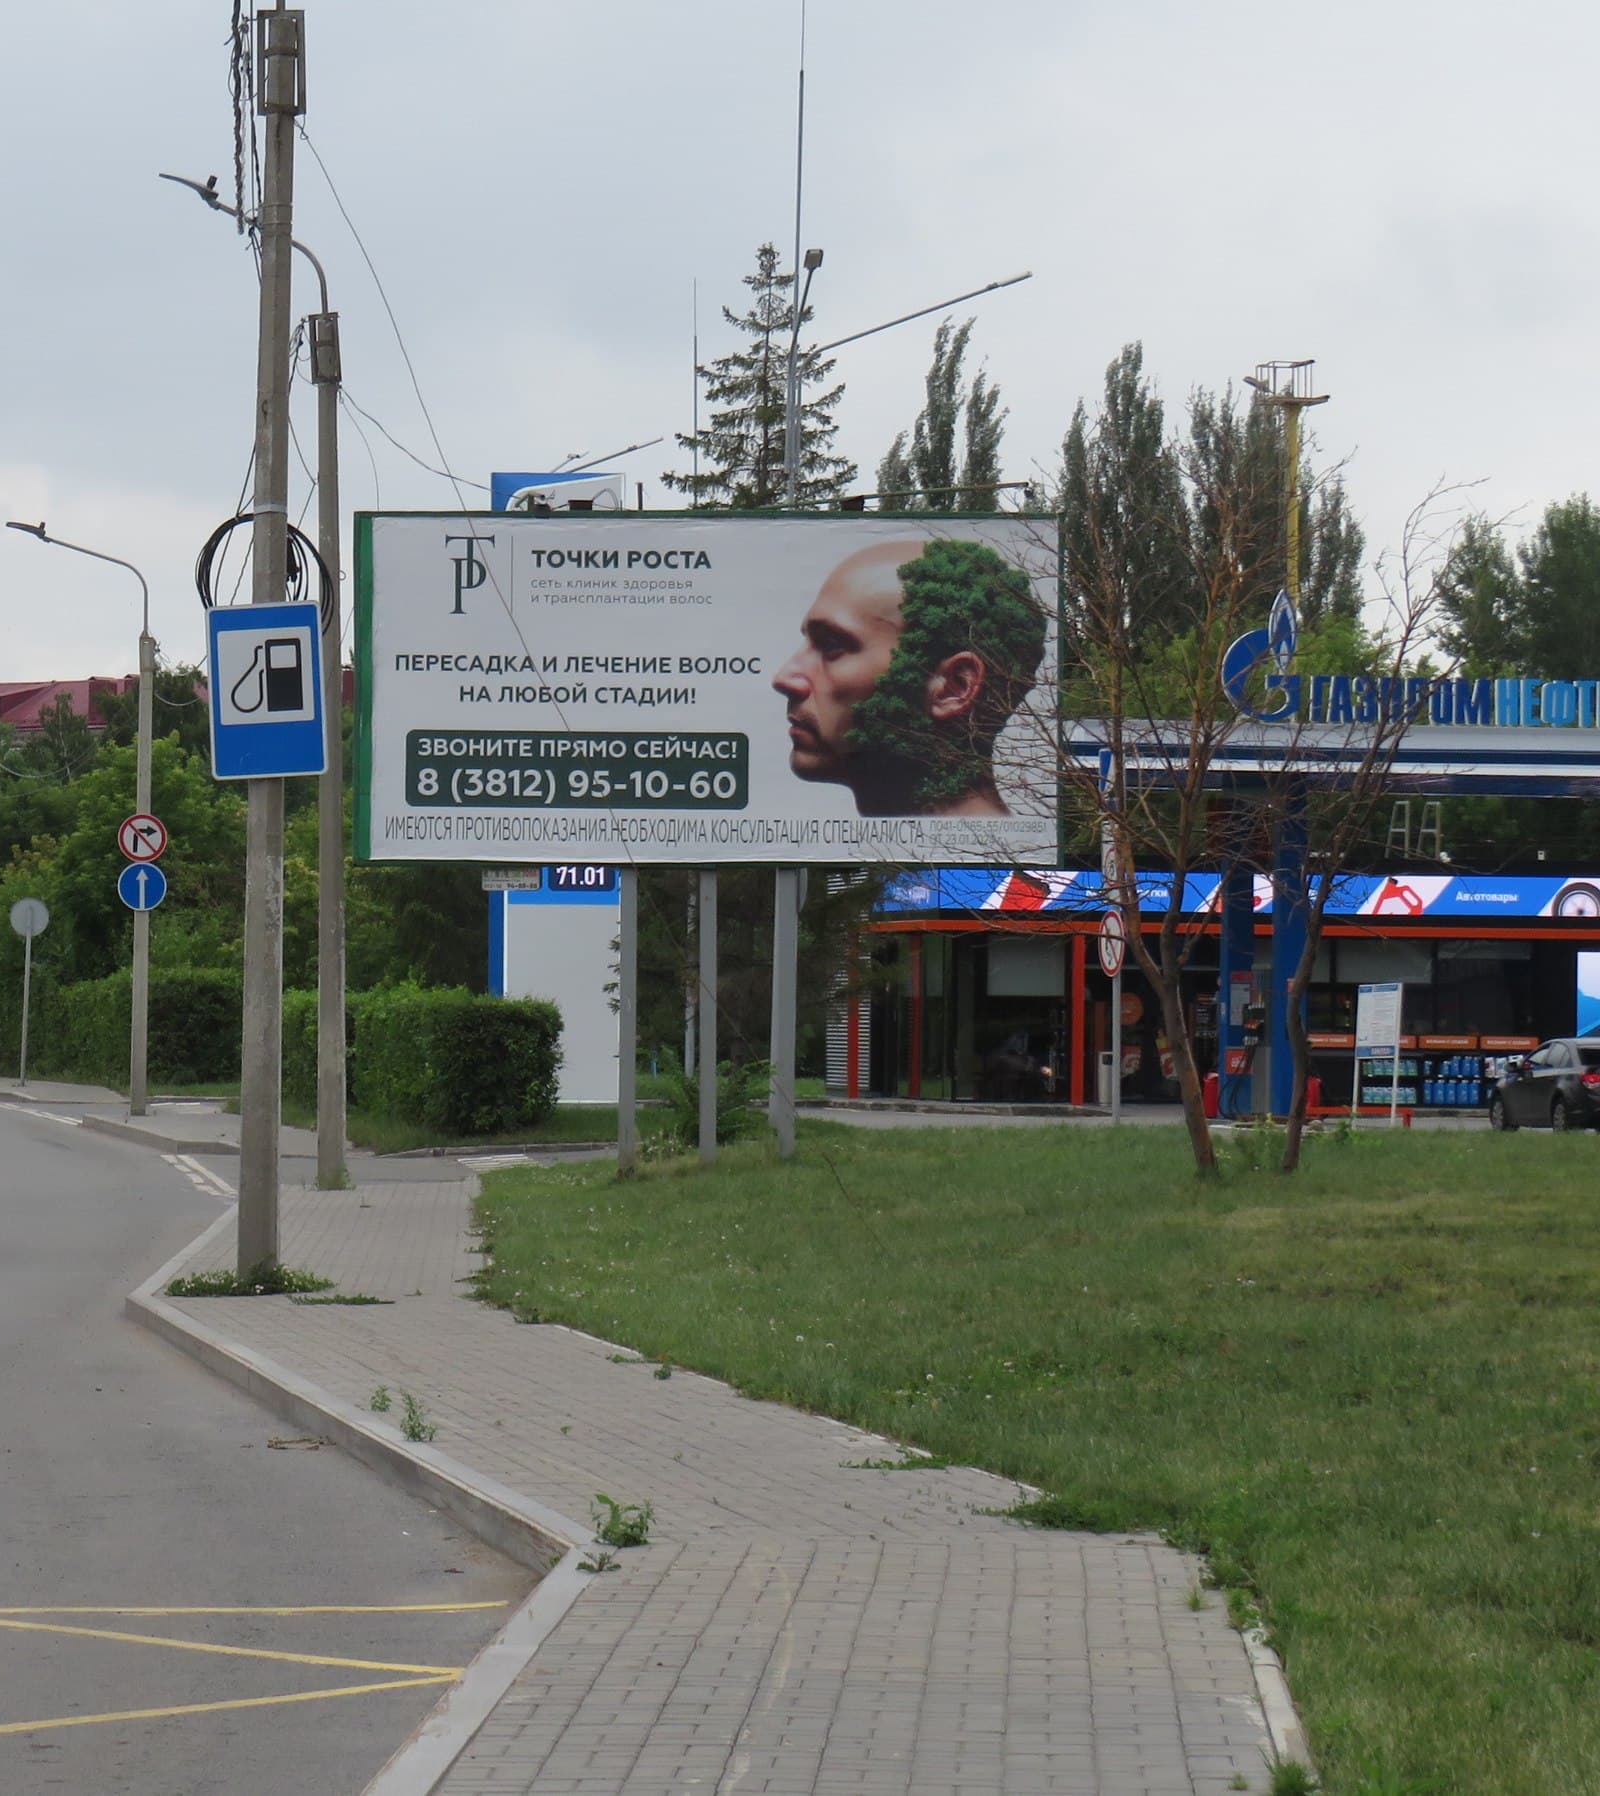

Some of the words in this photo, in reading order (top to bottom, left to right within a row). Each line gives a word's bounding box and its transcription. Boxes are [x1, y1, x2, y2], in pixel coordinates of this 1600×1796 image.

[531, 549, 619, 569] ТОЧКИ
[627, 550, 712, 570] РОСТА
[530, 578, 562, 589] сеть
[566, 578, 617, 589] клиник
[623, 579, 693, 592] здоровья
[530, 594, 539, 604] и
[543, 593, 664, 606] трансплантации
[669, 593, 713, 605] волос
[395, 654, 535, 675] ПЕРЕСАДКА
[542, 656, 557, 673] И
[564, 656, 672, 674] ЛЕЧЕНИЕ
[679, 657, 762, 675] ВОЛОС
[459, 686, 492, 703] НА
[498, 681, 587, 704] ЛЮБОЙ
[594, 686, 696, 708] СТАДИИ!
[417, 738, 533, 757] ЗВОНИТЕ
[540, 739, 627, 759] ПРЯМО
[633, 735, 737, 759] СЕЙЧАС!
[417, 767, 439, 796] 8
[451, 768, 556, 804] (3812)
[568, 769, 737, 799] 95-10-60
[385, 815, 451, 841] ИМЕЮТСЯ
[711, 818, 819, 848] КОНСУЛЬТАЦИЯ
[823, 820, 923, 849] СПЕЦИАЛИСТА
[555, 866, 605, 886] 71.01
[1455, 889, 1518, 904] Автотовары
